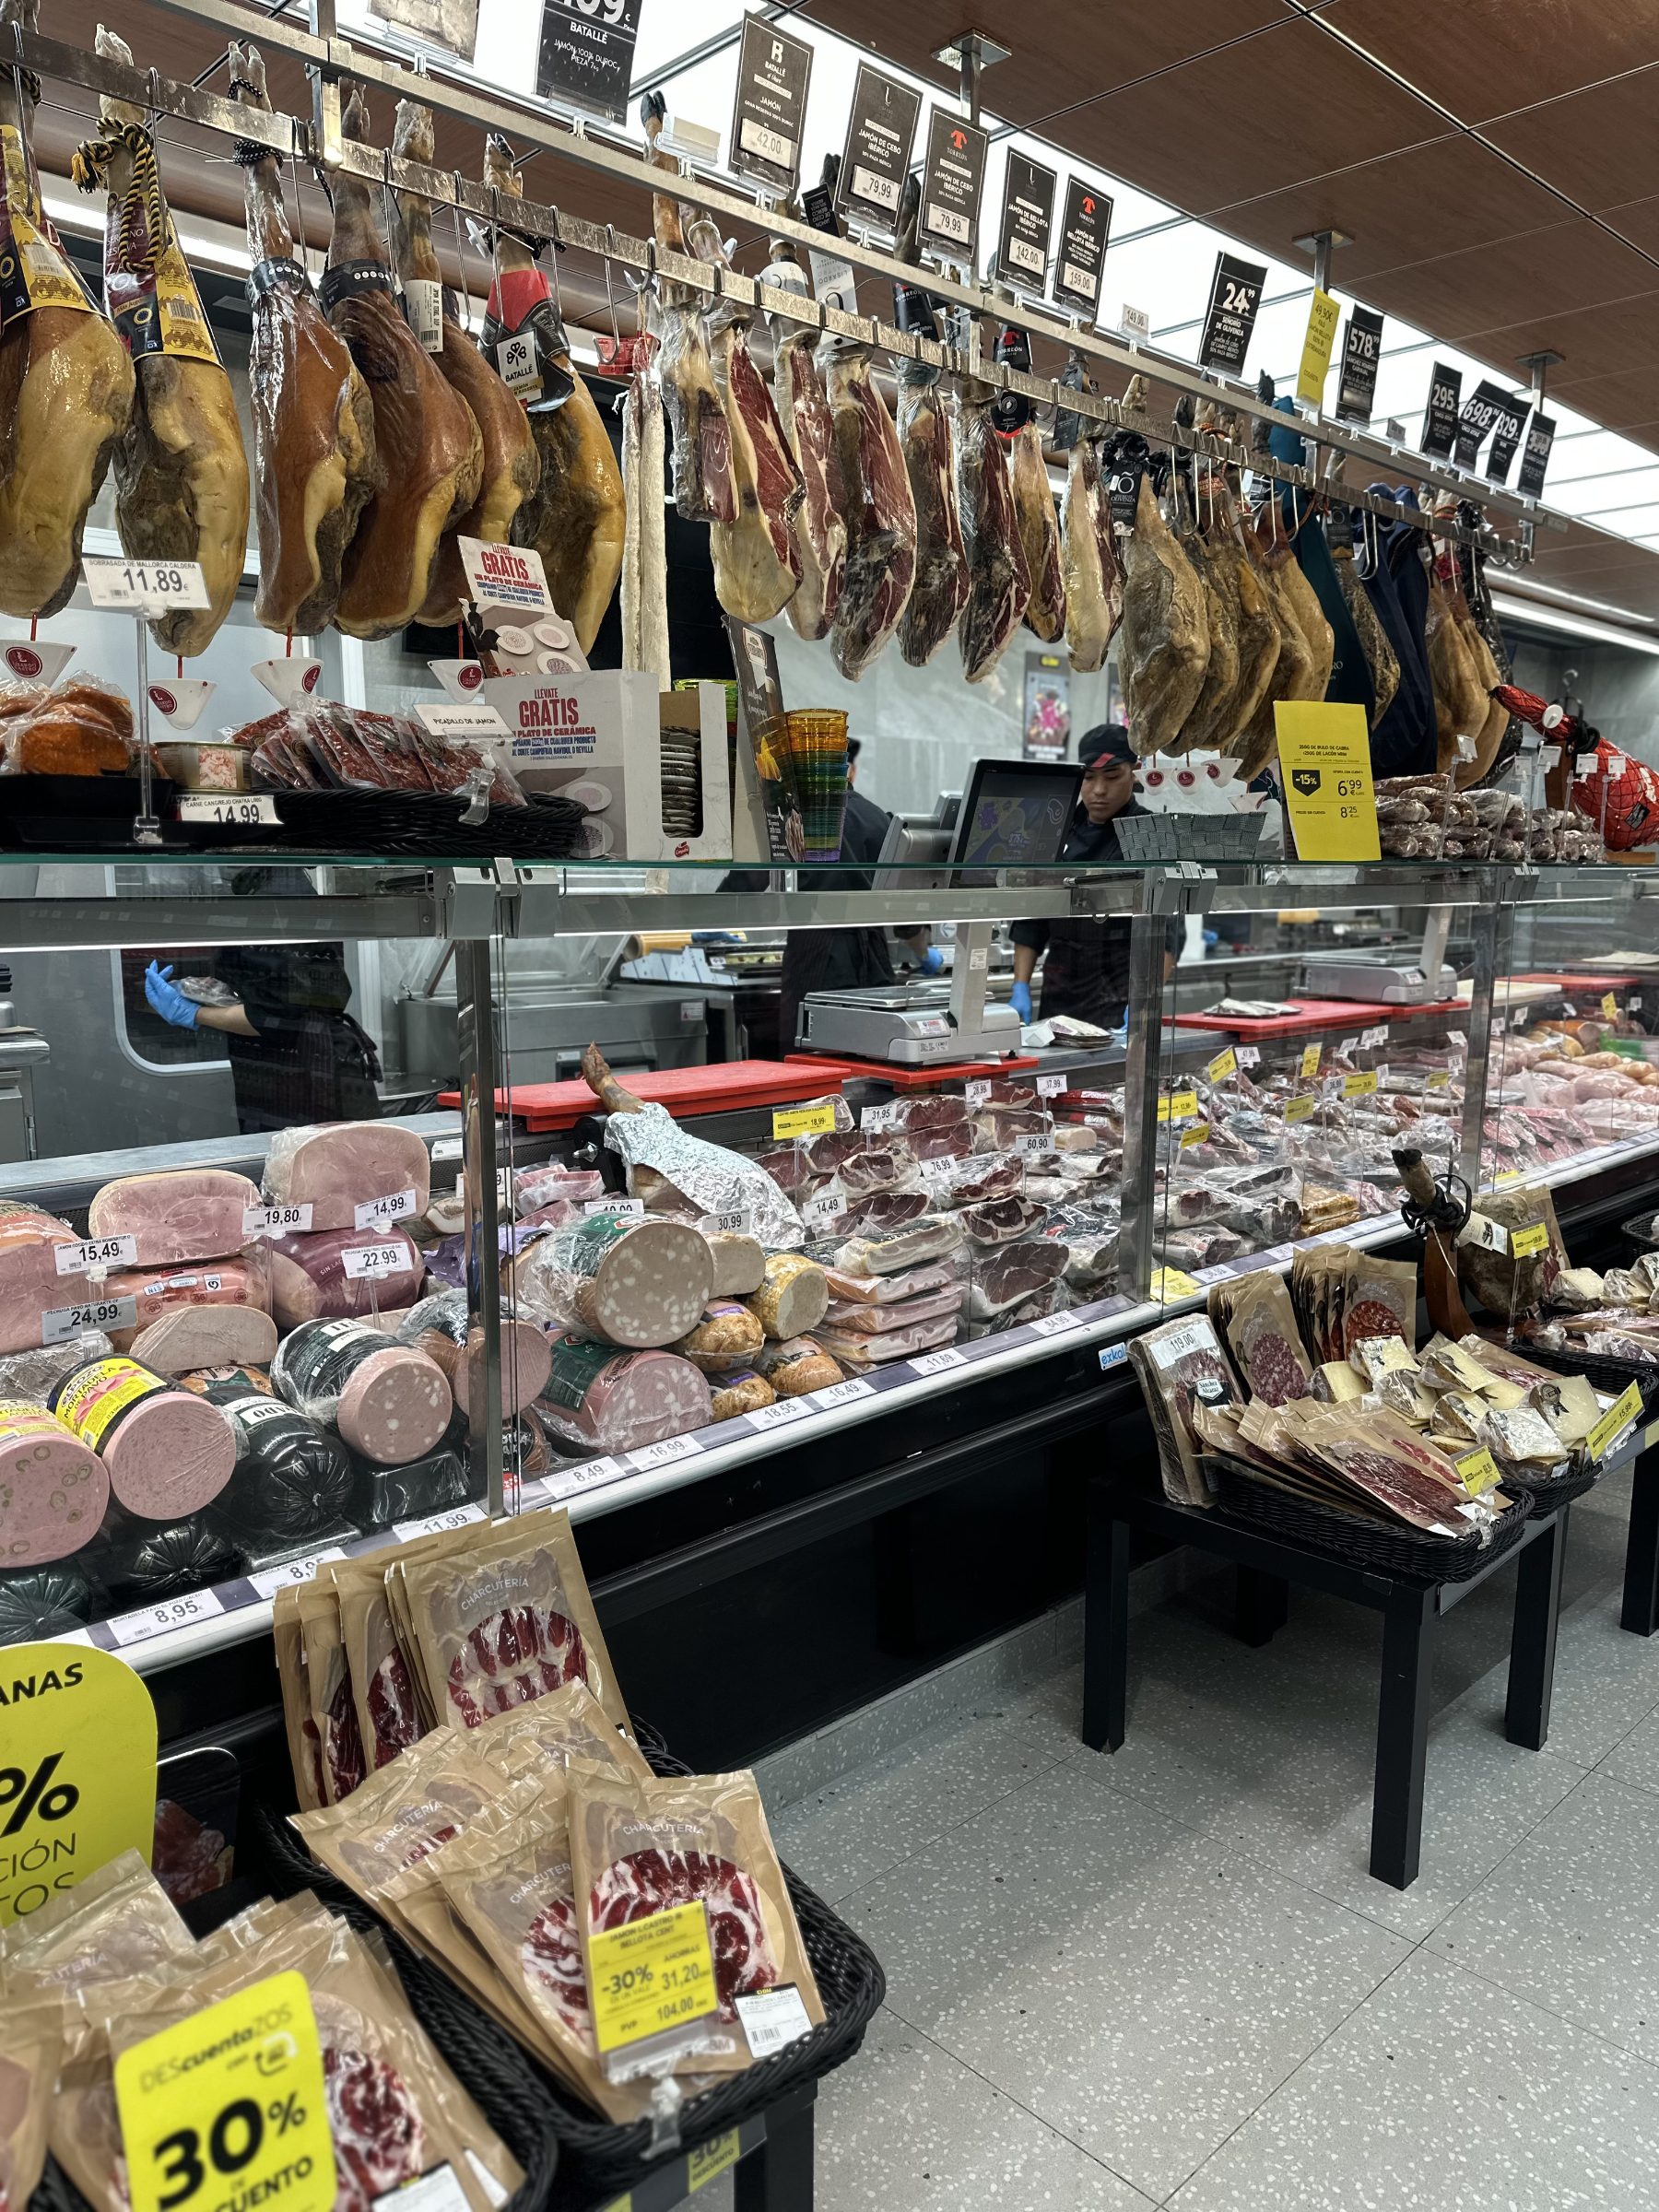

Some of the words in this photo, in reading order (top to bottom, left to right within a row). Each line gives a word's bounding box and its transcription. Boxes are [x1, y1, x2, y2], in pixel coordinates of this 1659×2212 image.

[571, 22, 607, 44] BATALLÉ
[554, 39, 576, 53] JAMÓN
[578, 47, 594, 60] 100%
[595, 55, 618, 68] DUROC
[571, 55, 588, 66] PIEZA
[760, 96, 782, 112] JAMÓN
[757, 131, 782, 155] 42,00
[858, 129, 877, 143] JAMÓN
[877, 137, 887, 147] DE
[887, 140, 901, 155] CEBO
[868, 142, 889, 158] IBÉRICO
[869, 177, 891, 198] 79,99
[935, 171, 952, 182] JAMÓN
[952, 176, 959, 185] DE
[960, 181, 973, 192] CEBO
[944, 183, 963, 195] IBÉRICO
[941, 214, 961, 232] 79,99
[1008, 203, 1024, 217] JAMÓN
[1030, 212, 1048, 228] BELLOTA
[1017, 244, 1038, 265] 142,00
[505, 364, 533, 382] BATALLÉ
[1432, 383, 1454, 410] 295
[481, 551, 529, 581] GRATIS
[124, 568, 182, 593] 11,89
[484, 575, 503, 584] PLATO
[512, 581, 543, 590] CERÁMICA
[535, 688, 559, 700] LLÉVATE
[519, 698, 579, 728] GRATIS
[518, 728, 541, 737] PLATO
[554, 725, 596, 736] CERÁMICA
[576, 745, 594, 754] REVILLA
[1295, 774, 1317, 785] -15%
[872, 1109, 890, 1121] 31,95
[1028, 1138, 1048, 1150] 60,90
[373, 1196, 405, 1217] 14,99
[817, 1199, 839, 1215] 14,49
[265, 1209, 300, 1225] 19,80
[718, 1214, 743, 1232] 30,99
[79, 1242, 120, 1262] 15,49
[320, 1266, 331, 1275] SIN
[71, 1304, 118, 1326] 24,99
[1101, 1347, 1125, 1365] exkal
[65, 1367, 116, 1418] MORTADELA
[82, 1376, 107, 1398] PAVO
[829, 1383, 860, 1399] 16,49
[764, 1403, 797, 1419] 18,55
[649, 1441, 685, 1459] 16,99
[572, 1465, 606, 1482] 8,49
[290, 1556, 324, 1580] 8,9
[461, 1576, 529, 1610] CHARCUTERÍA
[112, 1609, 146, 1624] MORTADELA
[154, 1600, 199, 1623] 8,95
[374, 1800, 443, 1853] CHARCUTERÍA
[510, 1863, 572, 1904] CHARCUTER
[610, 1928, 636, 1942] JAMON
[620, 1933, 653, 1949] BELLOTA
[656, 1924, 675, 1936] CENT
[664, 1945, 700, 1962] AHORRAS
[602, 1962, 653, 1994] -30%
[662, 1962, 699, 1990] 31,20
[657, 1995, 693, 2020] 104,00
[620, 2020, 638, 2031] PVP
[153, 2090, 306, 2212] 30%
[692, 2148, 734, 2181] DESCUENTO
